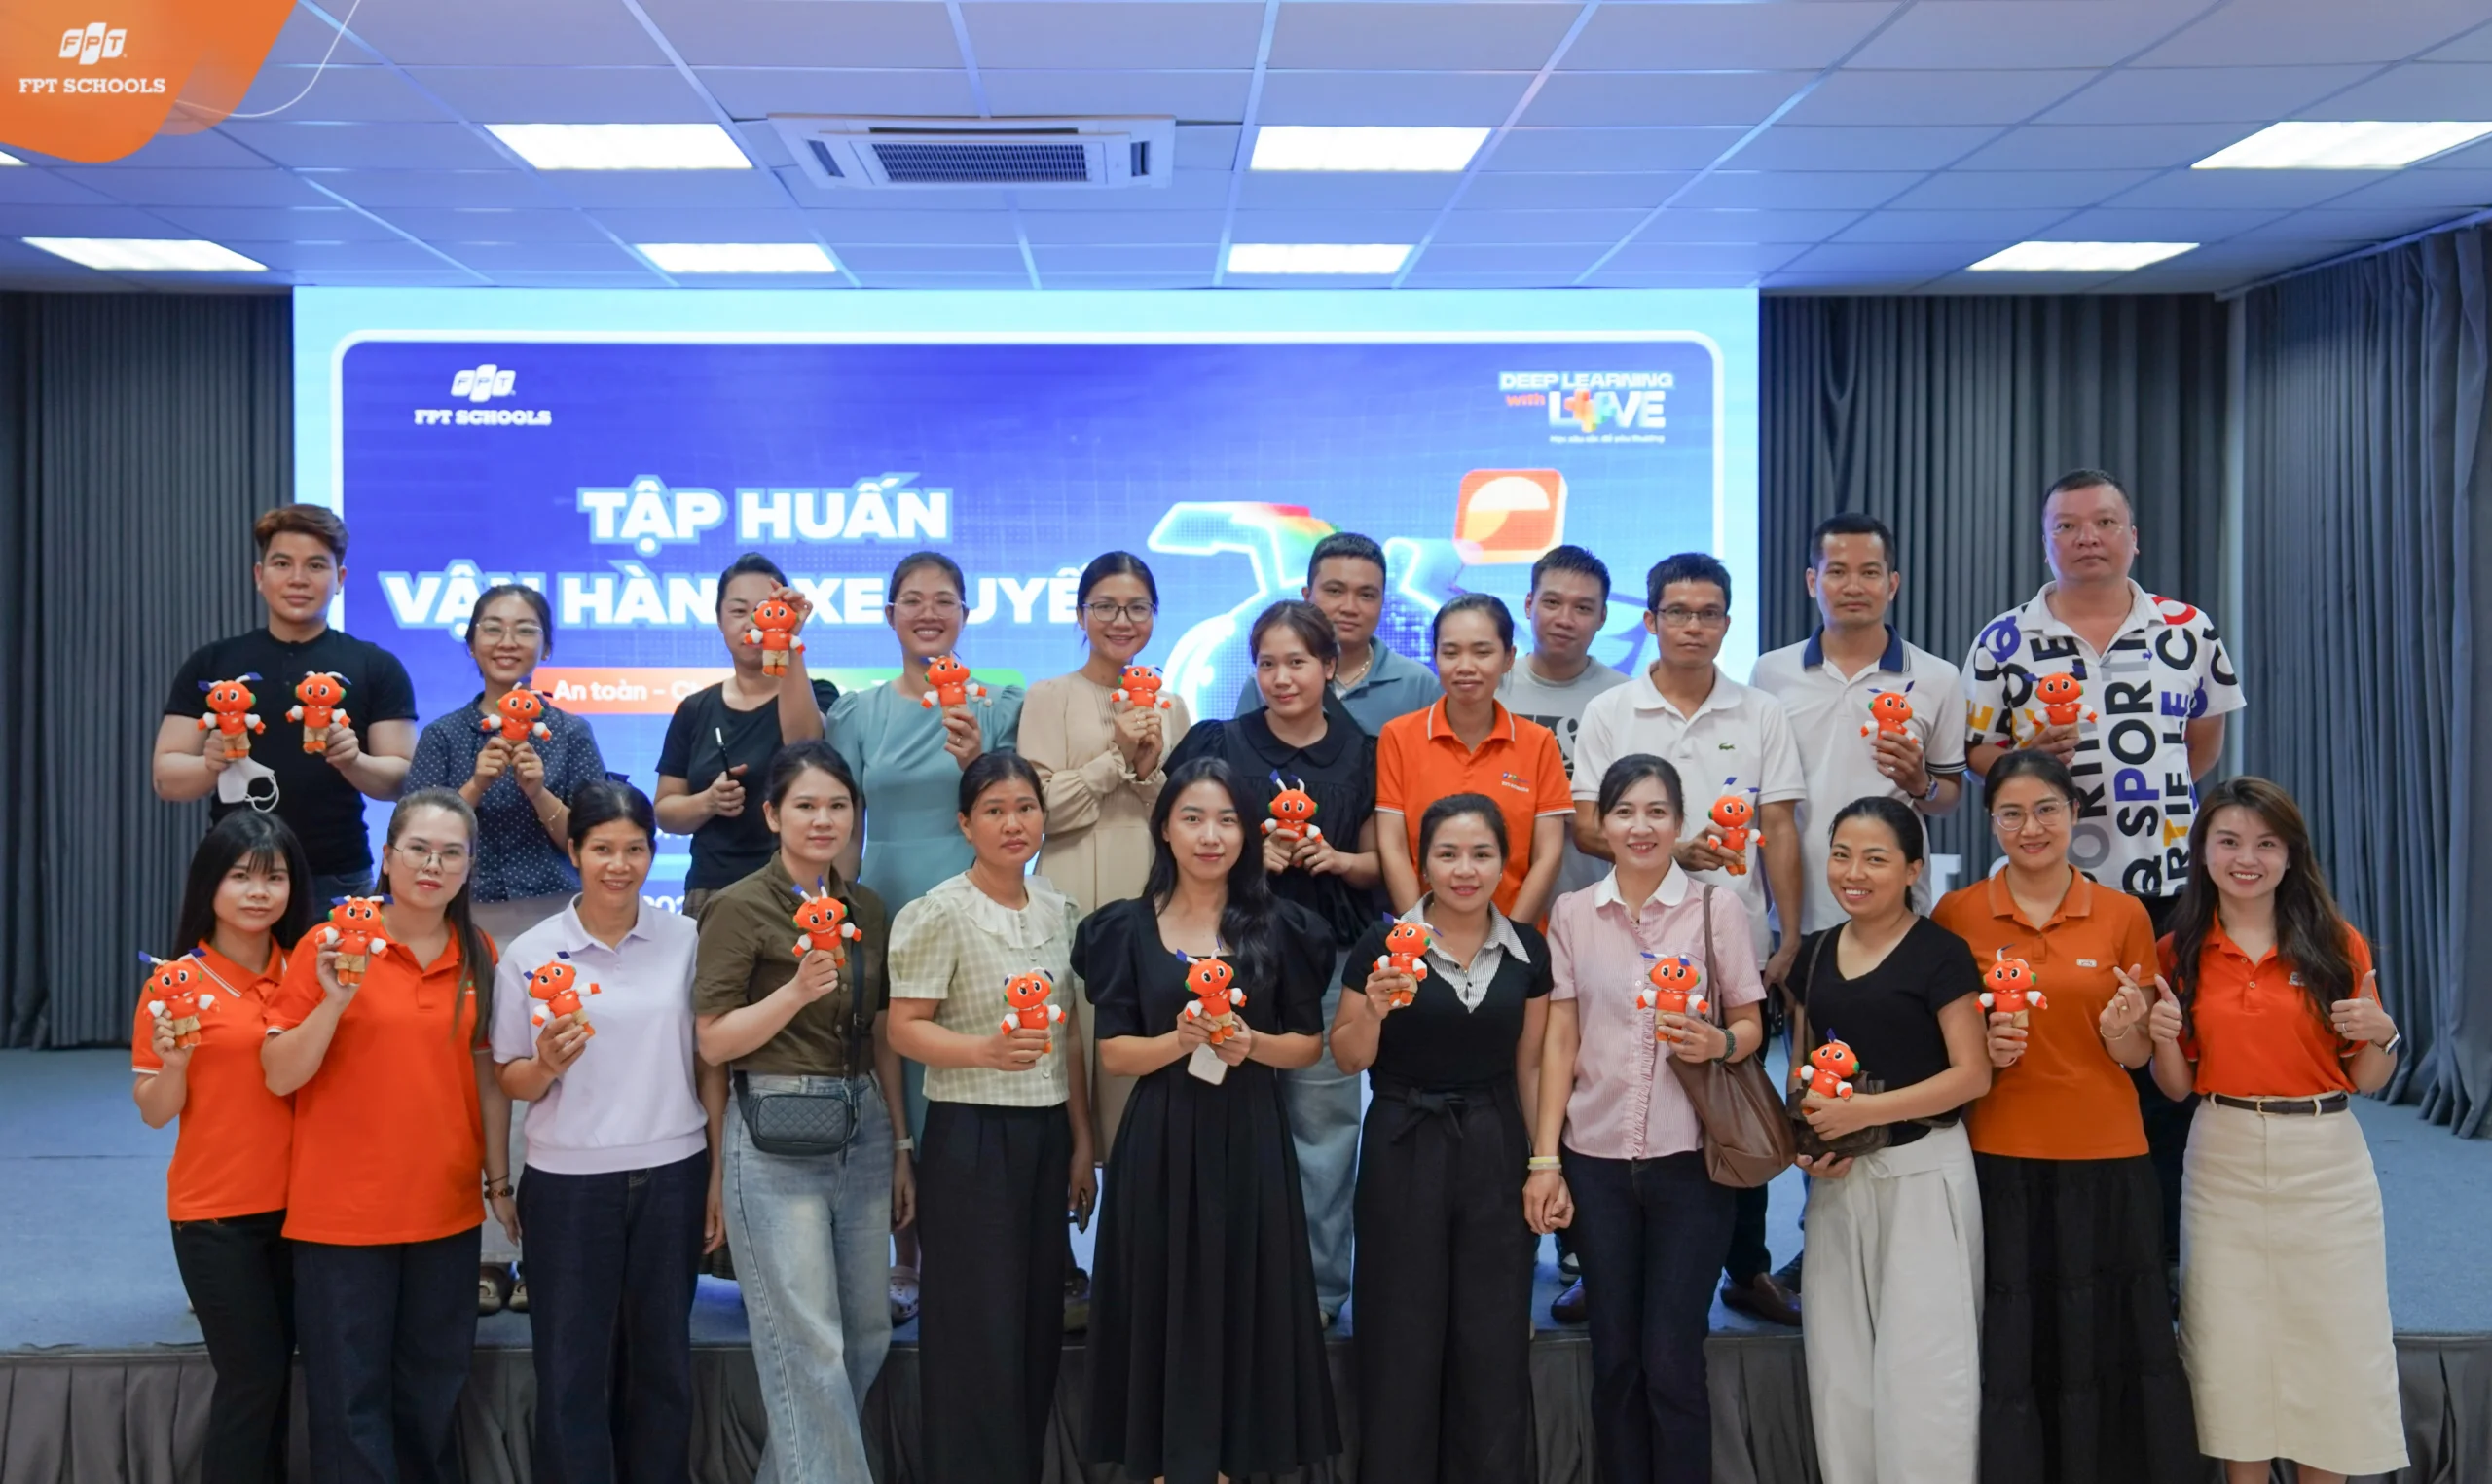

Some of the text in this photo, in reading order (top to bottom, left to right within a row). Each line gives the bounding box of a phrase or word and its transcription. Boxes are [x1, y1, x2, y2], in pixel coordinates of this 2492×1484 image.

[451, 364, 516, 403] FPT
[1501, 372, 1673, 389] DEEP LEARNING
[1506, 393, 1546, 406] with
[414, 410, 552, 425] FPT SCHOOLS
[581, 475, 949, 554] TẬP HUẤN
[385, 563, 538, 638] VẬ
[562, 564, 718, 624] HÀN
[791, 577, 884, 624] XE
[554, 680, 586, 702] An
[590, 679, 647, 702] toàn
